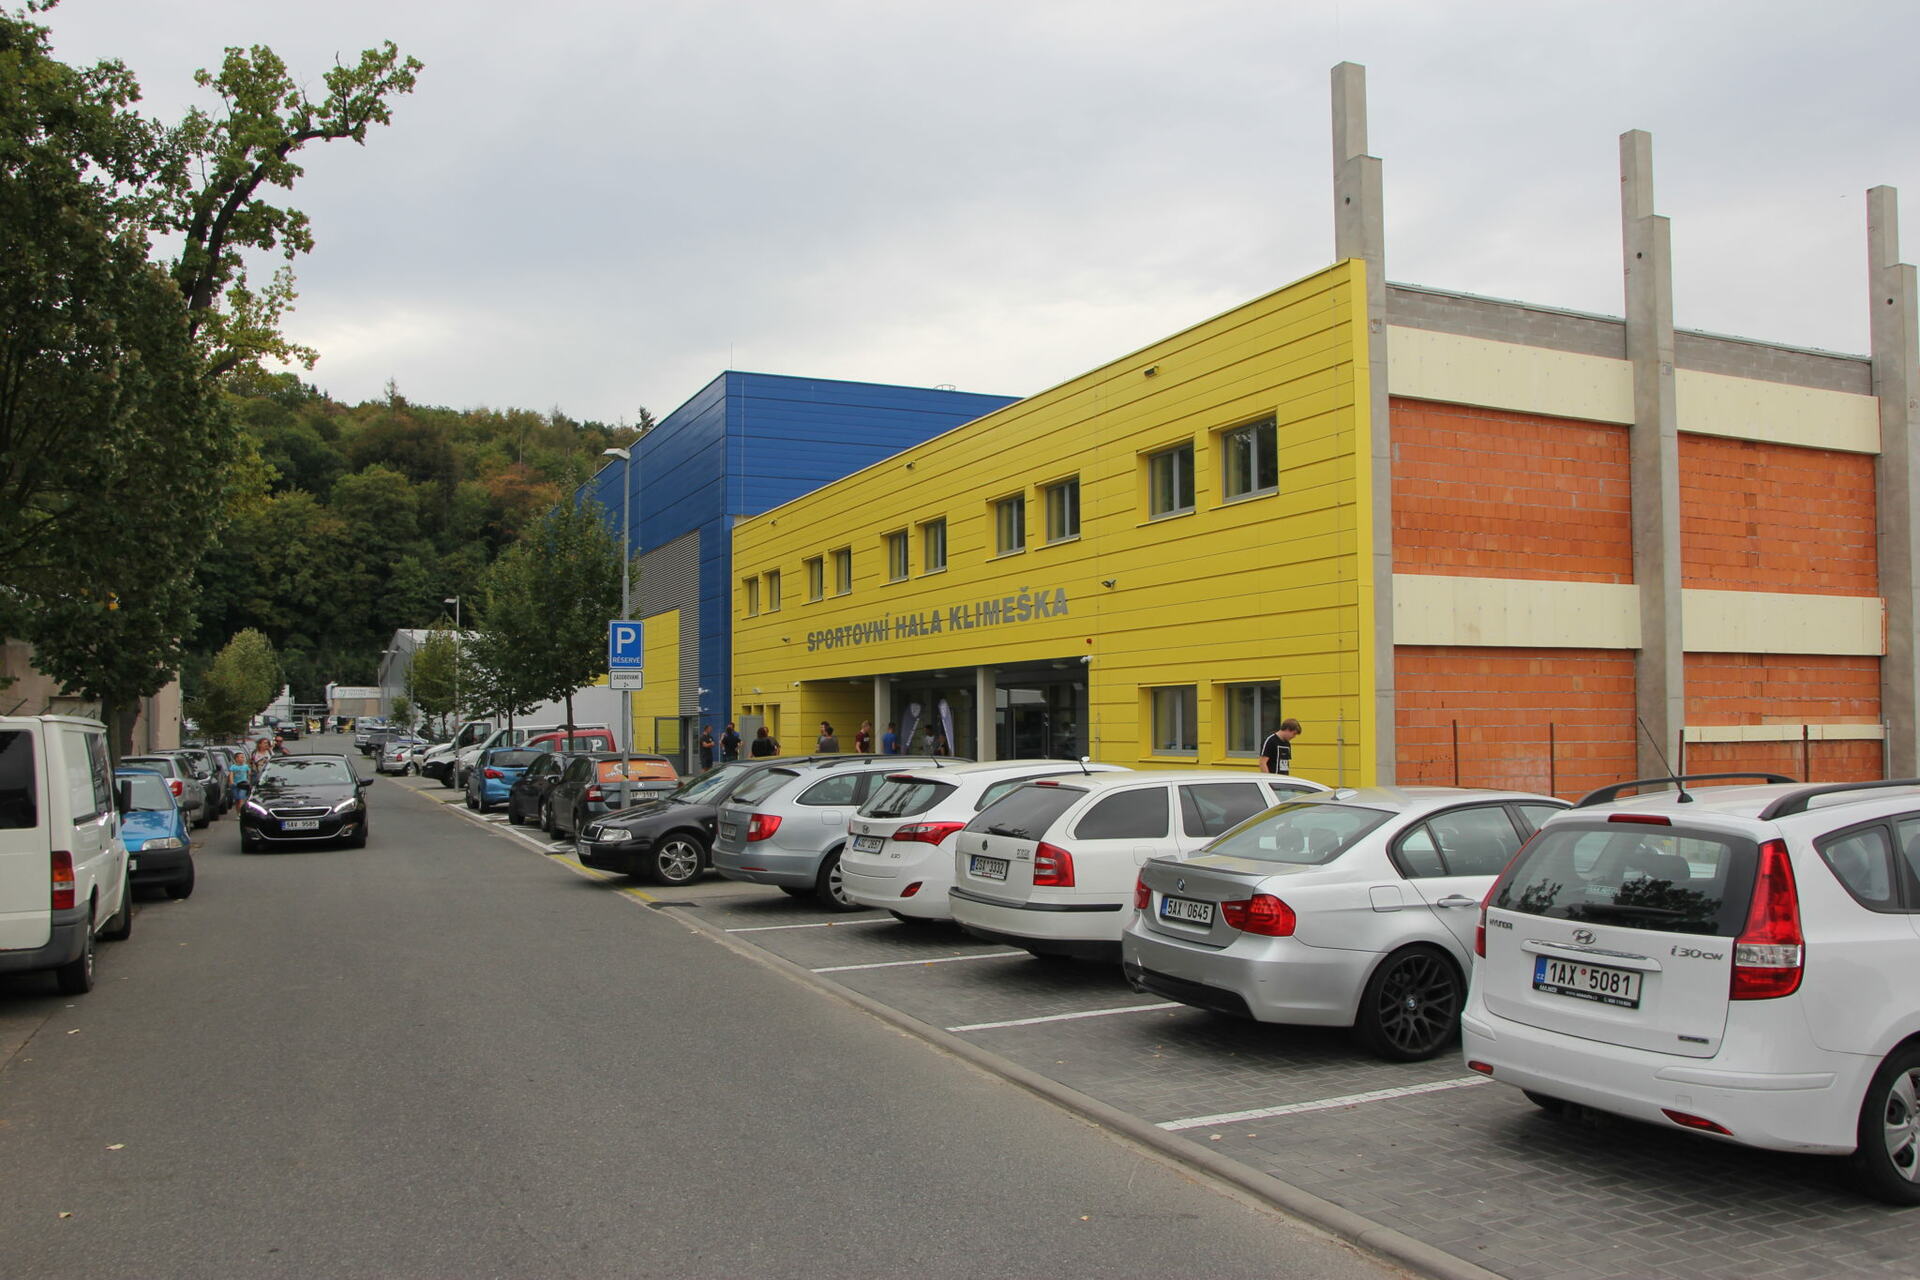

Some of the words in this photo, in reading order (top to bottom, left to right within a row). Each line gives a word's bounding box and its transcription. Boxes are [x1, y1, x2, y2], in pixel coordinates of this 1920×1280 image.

[807, 613, 890, 652] SPORTOVNÍ
[895, 610, 943, 639] HALA
[949, 586, 1069, 632] KLIMEŠKA
[616, 627, 636, 654] P
[1167, 900, 1182, 915] 5AX
[1187, 903, 1209, 921] 0645
[1550, 962, 1577, 986] 1AX
[1589, 969, 1631, 996] 5081
